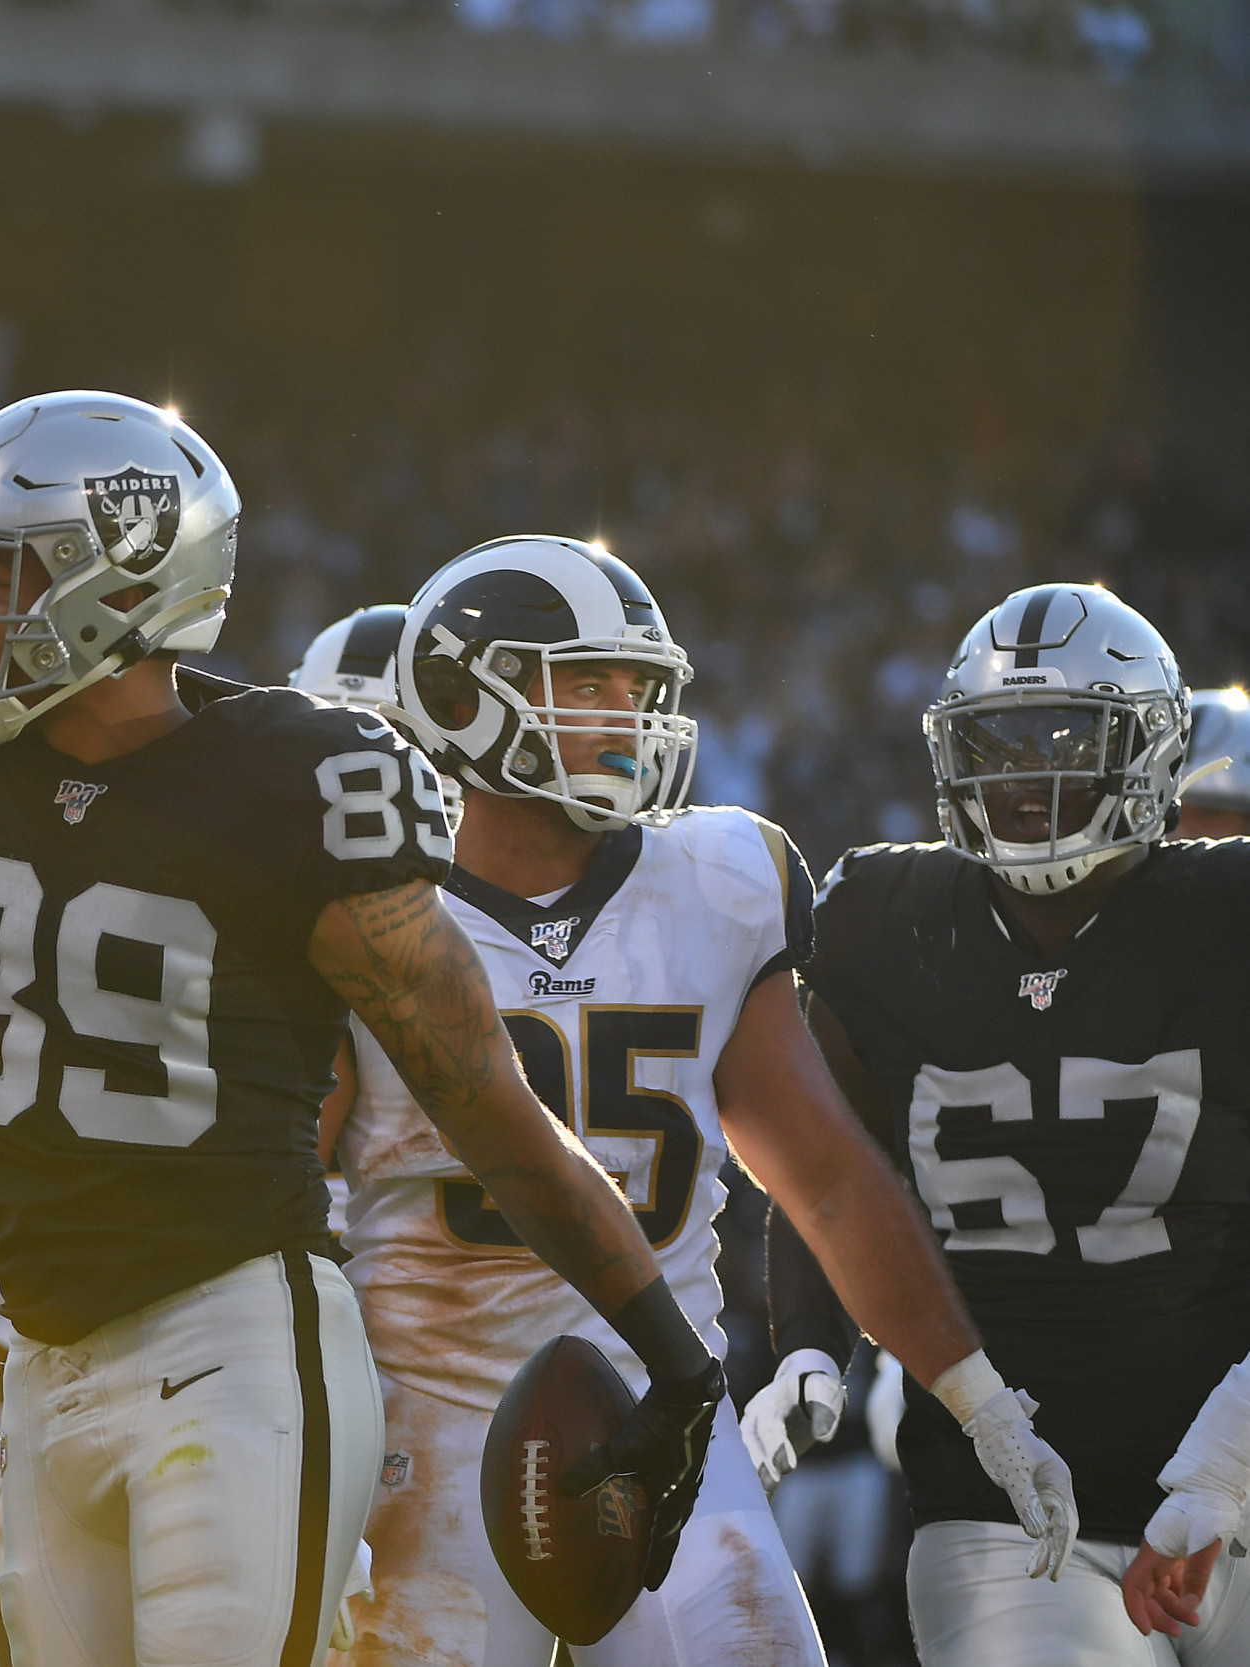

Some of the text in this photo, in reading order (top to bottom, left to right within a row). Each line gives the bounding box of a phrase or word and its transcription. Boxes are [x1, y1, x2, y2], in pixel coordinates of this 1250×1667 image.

[95, 478, 171, 493] RAIDERS
[1002, 675, 1047, 686] RAIDERS
[315, 750, 456, 863] 89
[529, 970, 597, 996] Rams
[907, 1047, 1203, 1265] 67
